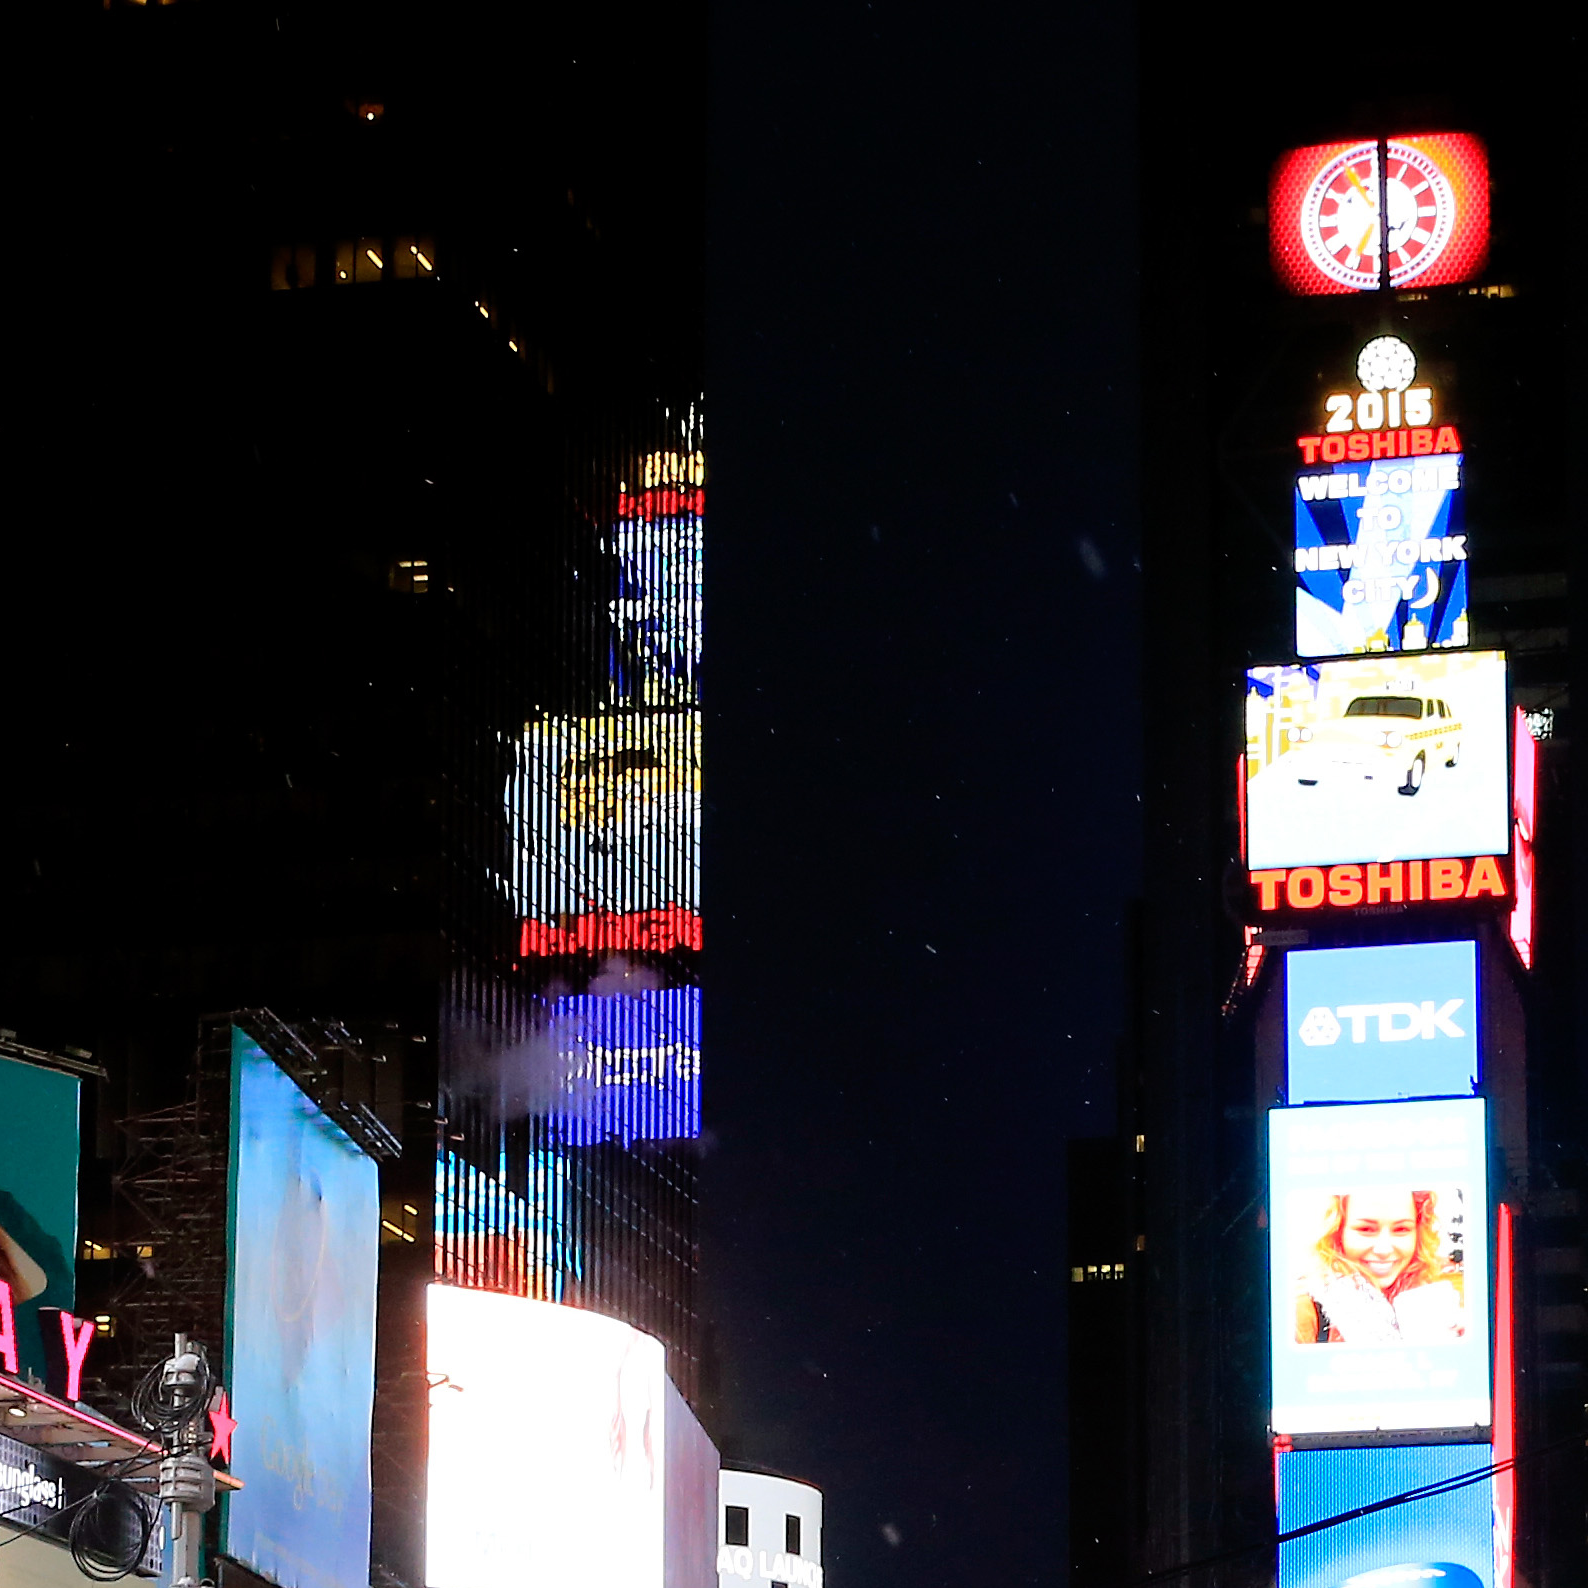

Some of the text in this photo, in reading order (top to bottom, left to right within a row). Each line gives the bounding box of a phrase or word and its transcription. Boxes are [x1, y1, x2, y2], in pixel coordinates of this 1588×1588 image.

[1324, 387, 1433, 433] 2015
[1297, 425, 1462, 464] TOSHIBA
[1297, 464, 1460, 501] WELCOME
[1356, 506, 1402, 531] TO
[1294, 534, 1468, 573] NEW YORK
[1342, 574, 1419, 604] CITY
[1250, 856, 1507, 911] TOSHIBA
[1336, 999, 1466, 1043] TDK
